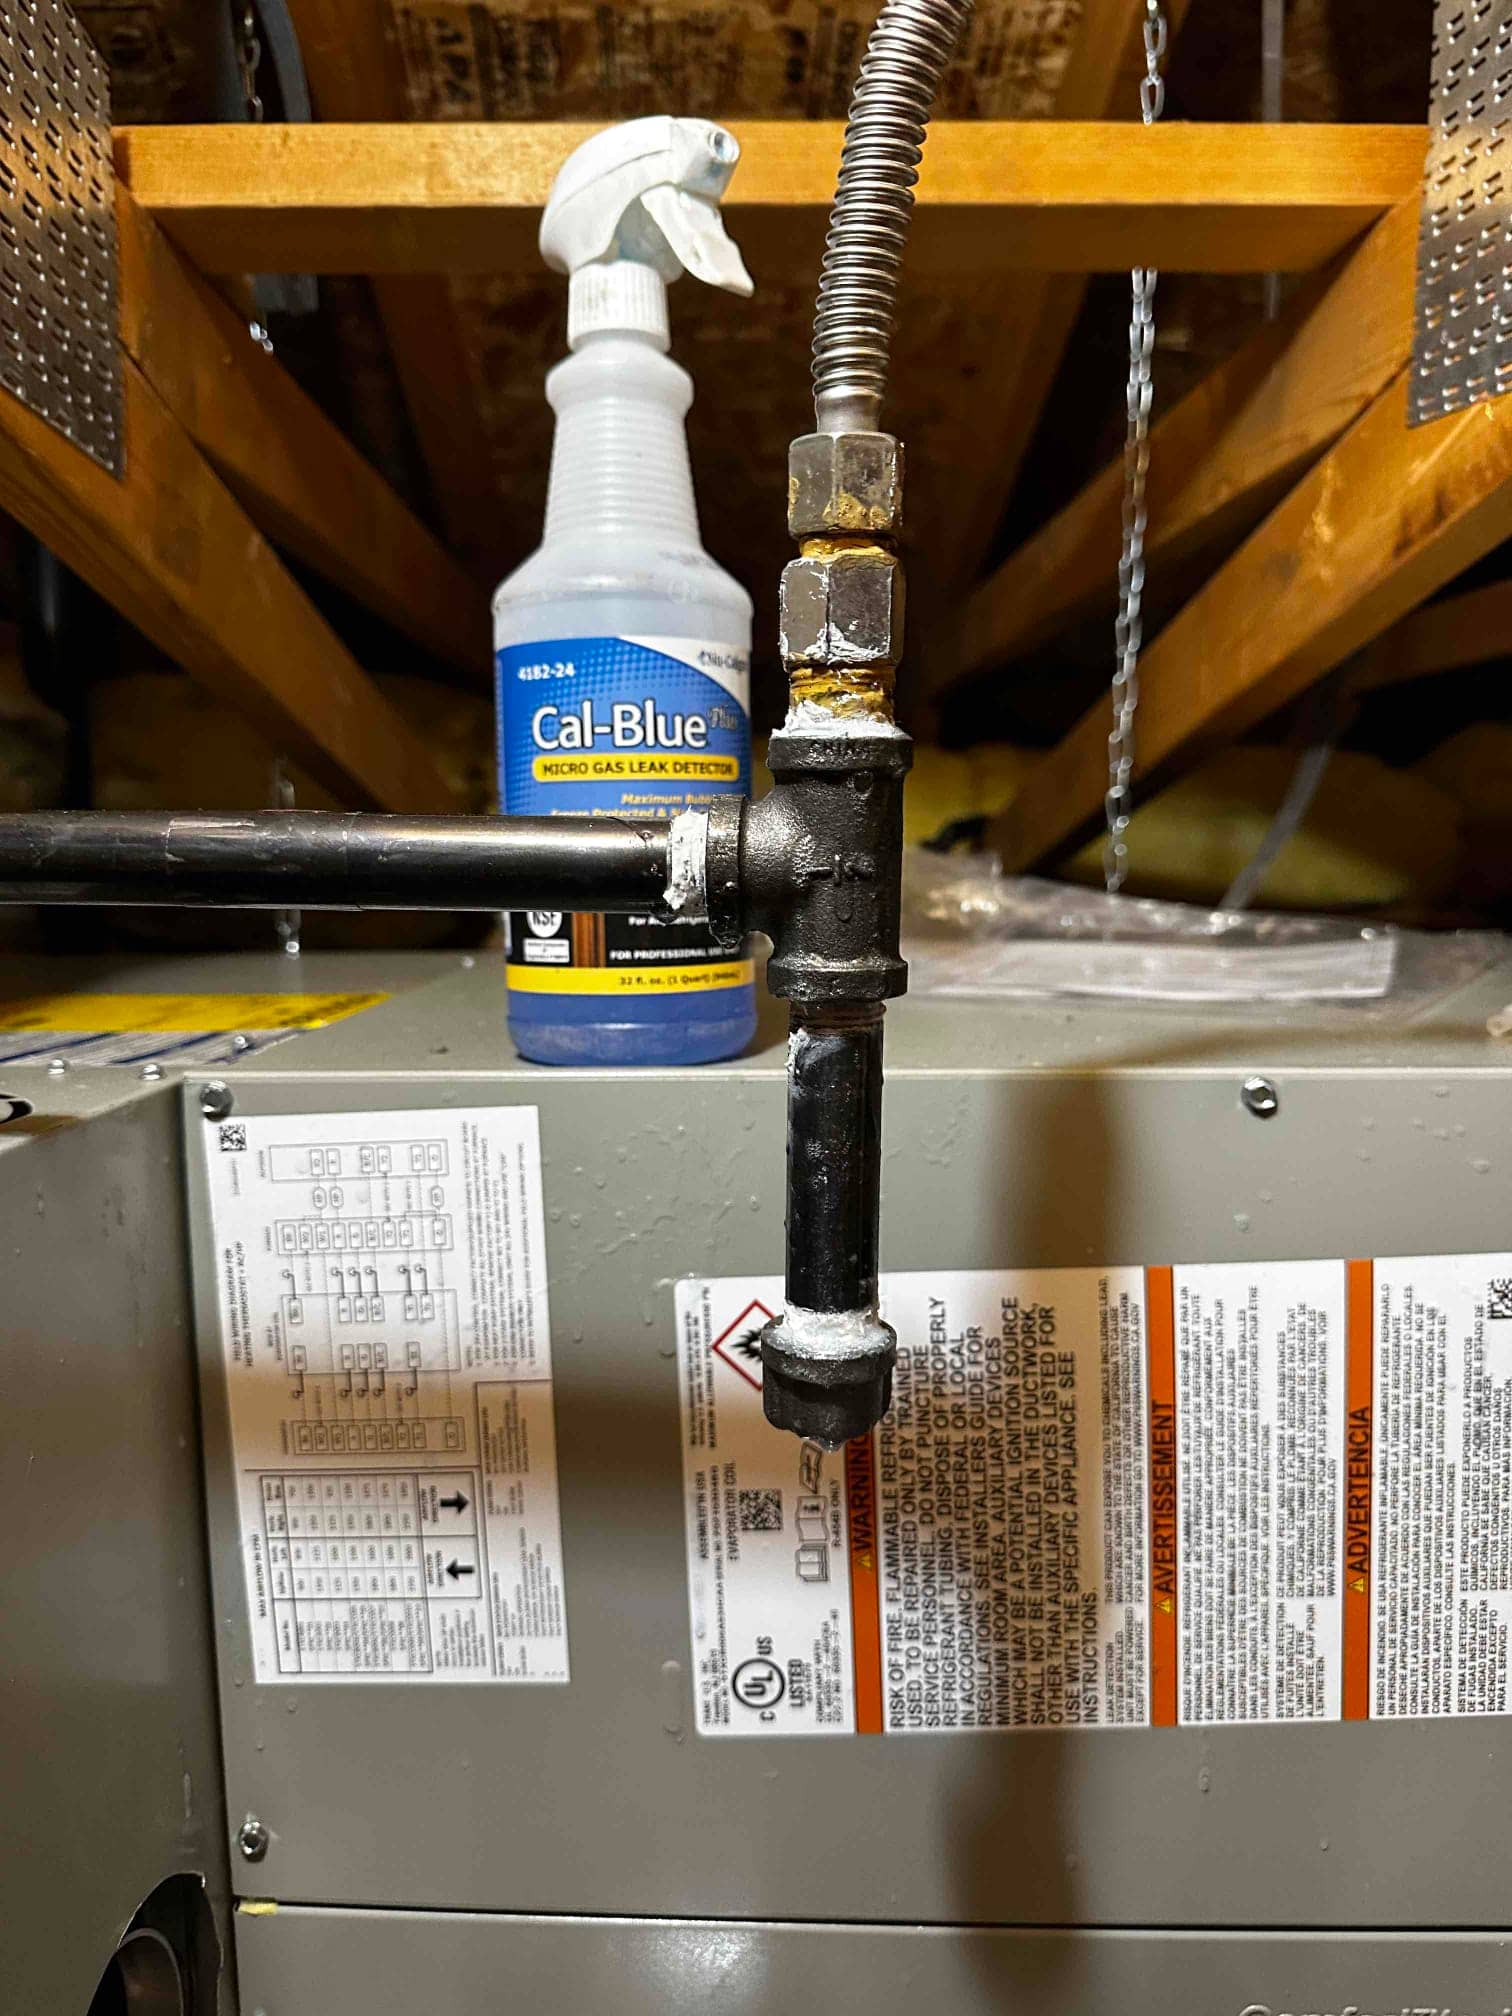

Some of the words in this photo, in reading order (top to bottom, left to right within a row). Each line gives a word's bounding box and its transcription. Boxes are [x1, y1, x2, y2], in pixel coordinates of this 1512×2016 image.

[518, 663, 576, 680] 4182-24
[532, 699, 707, 750] Cal-Blue
[543, 763, 589, 776] MICRO
[593, 762, 624, 775] GAS
[629, 761, 668, 775] LEAK
[673, 761, 734, 775] DETECTOR
[593, 807, 652, 817] Protected
[622, 793, 681, 805] Maximum
[628, 915, 646, 926] For
[609, 949, 632, 960] FOR
[633, 948, 707, 960] PROFESSIONAL
[620, 977, 632, 986] 32
[929, 1298, 948, 1399] PROPERLY
[967, 1327, 983, 1367] FOR
[1002, 1298, 1020, 1379] SOURCE
[1039, 1307, 1055, 1347] FOR
[950, 1332, 966, 1398] LOCAL
[985, 1337, 1001, 1420] DEVICES
[1022, 1303, 1040, 1421] DUCTWORK,
[1040, 1352, 1056, 1419] LISTED
[1058, 1352, 1075, 1389] SEE
[897, 1348, 913, 1430] TRAINED
[914, 1345, 931, 1449] PUNCTURE
[968, 1373, 985, 1432] GUIDE
[932, 1407, 949, 1431] OF
[952, 1403, 967, 1431] OR
[1004, 1384, 1022, 1466] IGNITION
[880, 1415, 897, 1484] REFRIG
[900, 1438, 914, 1461] BY
[1024, 1427, 1040, 1462] THE
[1042, 1425, 1058, 1505] DEVICES
[1059, 1397, 1076, 1506] APPLIANCE.
[724, 1463, 736, 1486] COIL
[831, 1479, 840, 1508] ONLY
[900, 1468, 916, 1516] ONLY
[917, 1457, 933, 1494] NOT
[933, 1436, 951, 1517] DISPOSE
[953, 1438, 969, 1523] FEDERAL
[970, 1437, 988, 1550] INSTALLERS
[987, 1427, 1004, 1523] AUXILIARY
[1025, 1468, 1040, 1486] IN
[1151, 1400, 1174, 1593] AVERTISSEMENT
[1348, 1407, 1369, 1573] ADVERTENCIA
[725, 1489, 738, 1560] EVAPORATOR
[918, 1499, 934, 1526] DO
[1007, 1473, 1024, 1574] POTENTIAL
[883, 1490, 900, 1604] FLAMMABLE
[902, 1521, 919, 1612] REPAIRED
[955, 1528, 971, 1574] WITH
[990, 1530, 1006, 1584] AREA.
[1025, 1492, 1042, 1592] INSTALLED
[1043, 1512, 1060, 1606] AUXILIARY
[1061, 1512, 1078, 1594] SPECIFIC
[919, 1533, 938, 1647] PERSONNEL.
[973, 1557, 989, 1591] SEE
[1010, 1580, 1025, 1591] A
[886, 1611, 902, 1654] FIRE.
[905, 1620, 920, 1642] BE
[991, 1589, 1008, 1644] ROOM
[1010, 1598, 1026, 1620] BE
[1027, 1599, 1043, 1621] BE
[1063, 1601, 1079, 1634] THE
[758, 1636, 771, 1655] US
[906, 1647, 921, 1670] TO
[957, 1581, 974, 1706] ACCORDANCE
[1011, 1627, 1027, 1663] MAY
[1028, 1629, 1044, 1663] NOT
[1046, 1611, 1062, 1659] THAN
[1082, 1587, 1098, 1723] INSTRUCTIONS.
[744, 1671, 773, 1697] UL
[788, 1659, 803, 1708] LISTED
[888, 1661, 903, 1683] OF
[938, 1604, 957, 1726] REFRIGERANT
[974, 1598, 992, 1725] REGULATIONS.
[1063, 1639, 1079, 1684] WITH
[889, 1690, 904, 1728] RISK
[907, 1678, 922, 1727] USED.
[923, 1655, 940, 1727] SERVICE
[993, 1648, 1010, 1725] MINIMUM
[1012, 1667, 1028, 1725] WHICH
[1029, 1672, 1045, 1724] SHALL
[1047, 1665, 1063, 1723] OTHER
[1064, 1691, 1080, 1723] USE
[961, 1710, 975, 1726] IN
